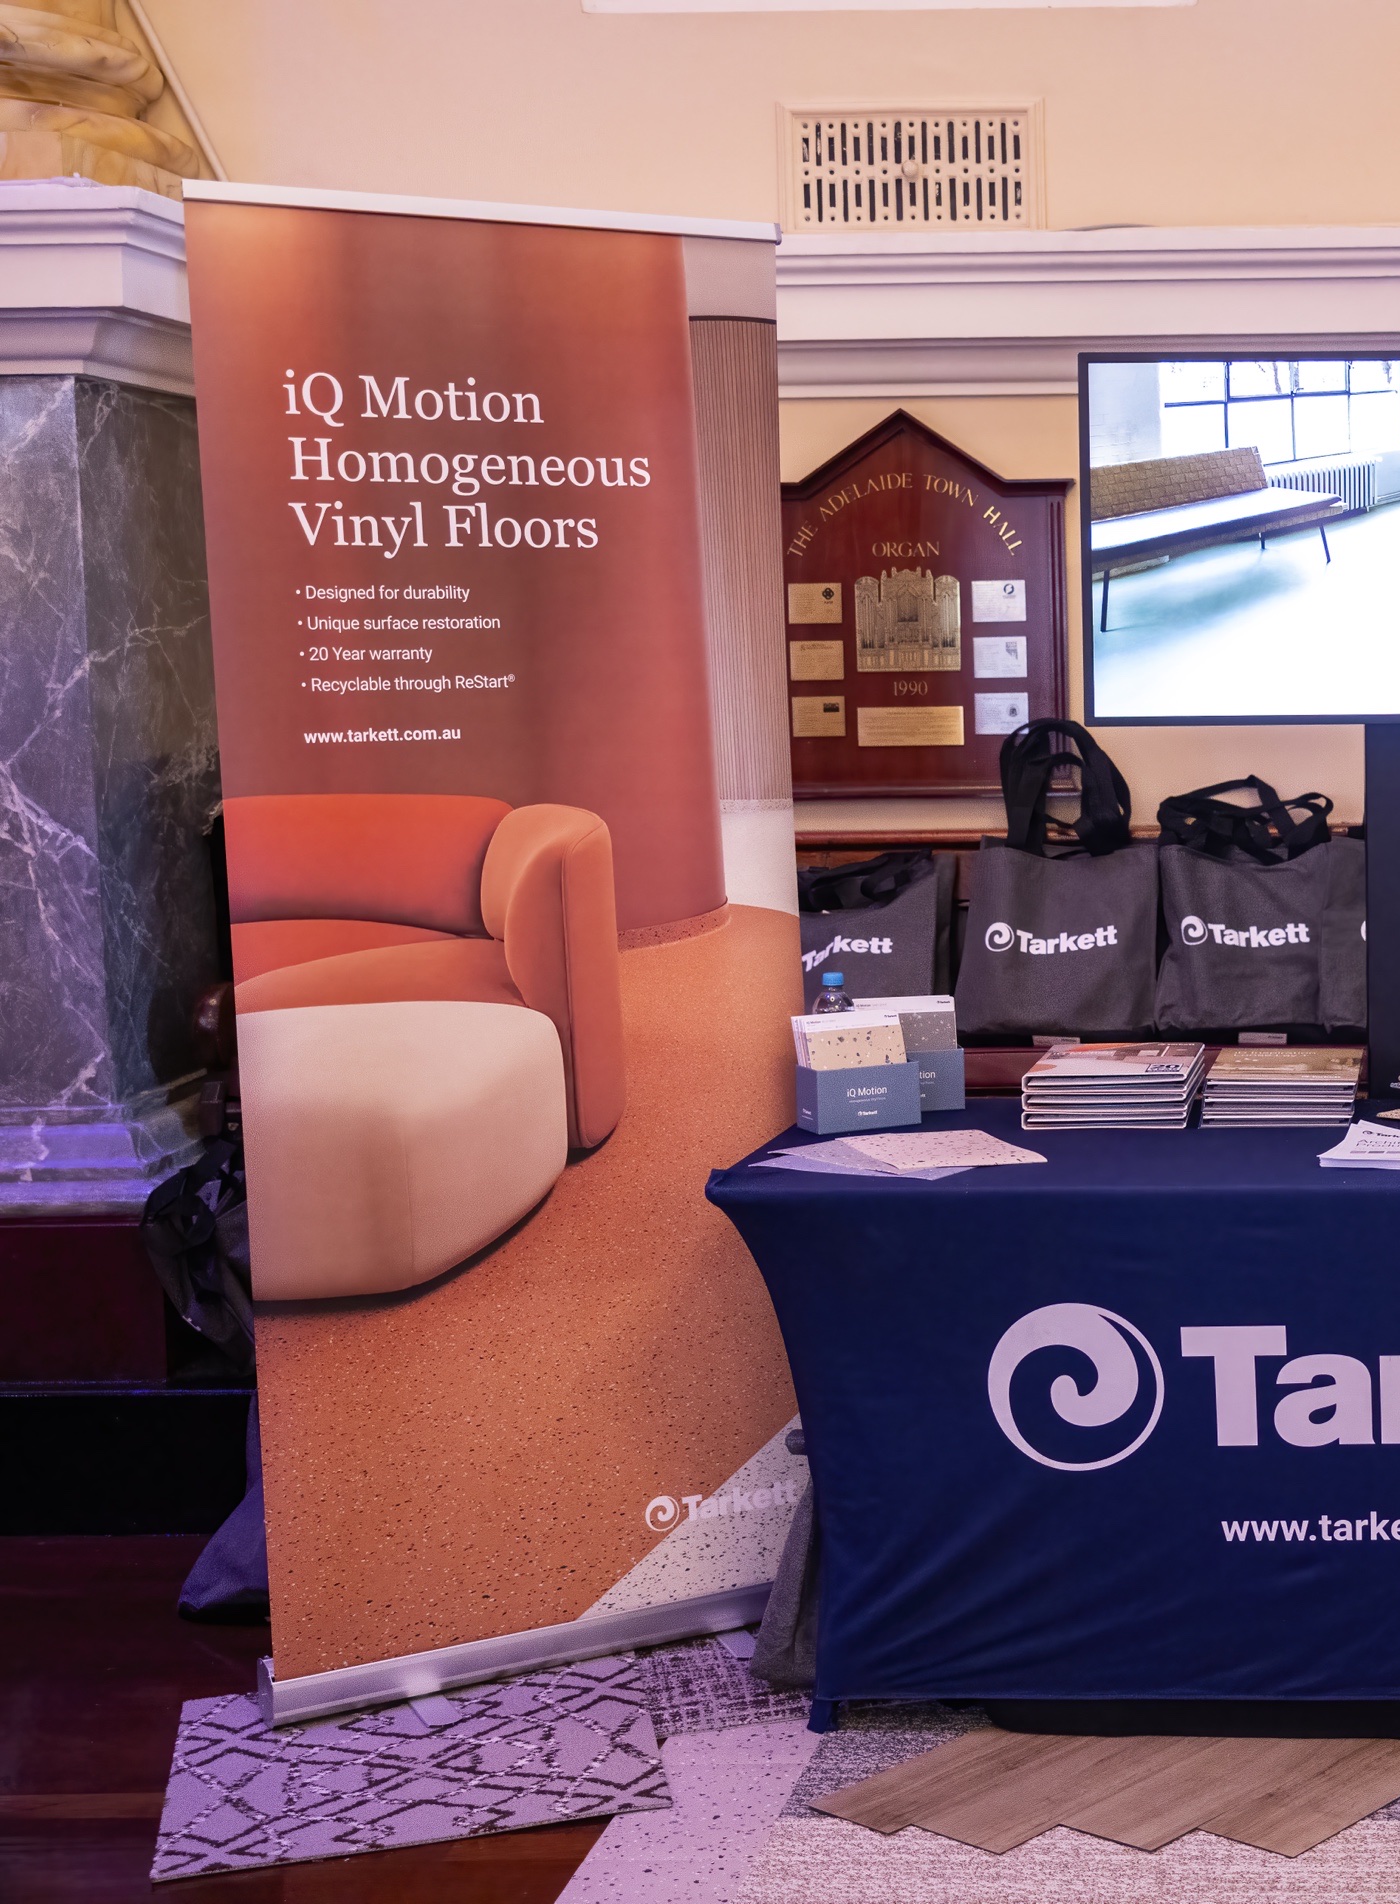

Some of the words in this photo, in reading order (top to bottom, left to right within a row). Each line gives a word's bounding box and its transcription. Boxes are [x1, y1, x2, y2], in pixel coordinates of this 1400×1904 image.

[283, 369, 344, 427] iQ
[358, 374, 545, 424] Motion
[288, 436, 651, 496] Homogeneous
[787, 519, 819, 558] THE
[819, 472, 914, 523] ADELAIDE
[922, 474, 980, 507] TOWN
[982, 505, 1024, 556] HALL
[288, 500, 428, 559] Vinyl
[443, 502, 599, 549] Floors
[871, 541, 941, 558] ORGAN
[305, 584, 375, 603] Designed
[379, 584, 400, 600] for
[403, 583, 470, 603] durability
[307, 616, 360, 634] Unique
[363, 615, 420, 631] surface
[422, 614, 501, 631] restoration
[309, 646, 329, 662] 20
[332, 646, 366, 662] Year
[369, 647, 433, 665] warranty
[311, 676, 391, 695] Recyclable
[394, 675, 452, 694] through
[892, 680, 929, 697] 1990
[303, 726, 462, 744] www.tarkett.com.au
[1016, 924, 1118, 955] Tarkett
[1207, 920, 1310, 950] Tarkett
[802, 935, 893, 972] Tarkett
[919, 1070, 936, 1079] tion
[847, 1088, 857, 1098] iQ
[858, 1086, 888, 1097] Motion
[681, 1478, 798, 1522] Tarkett
